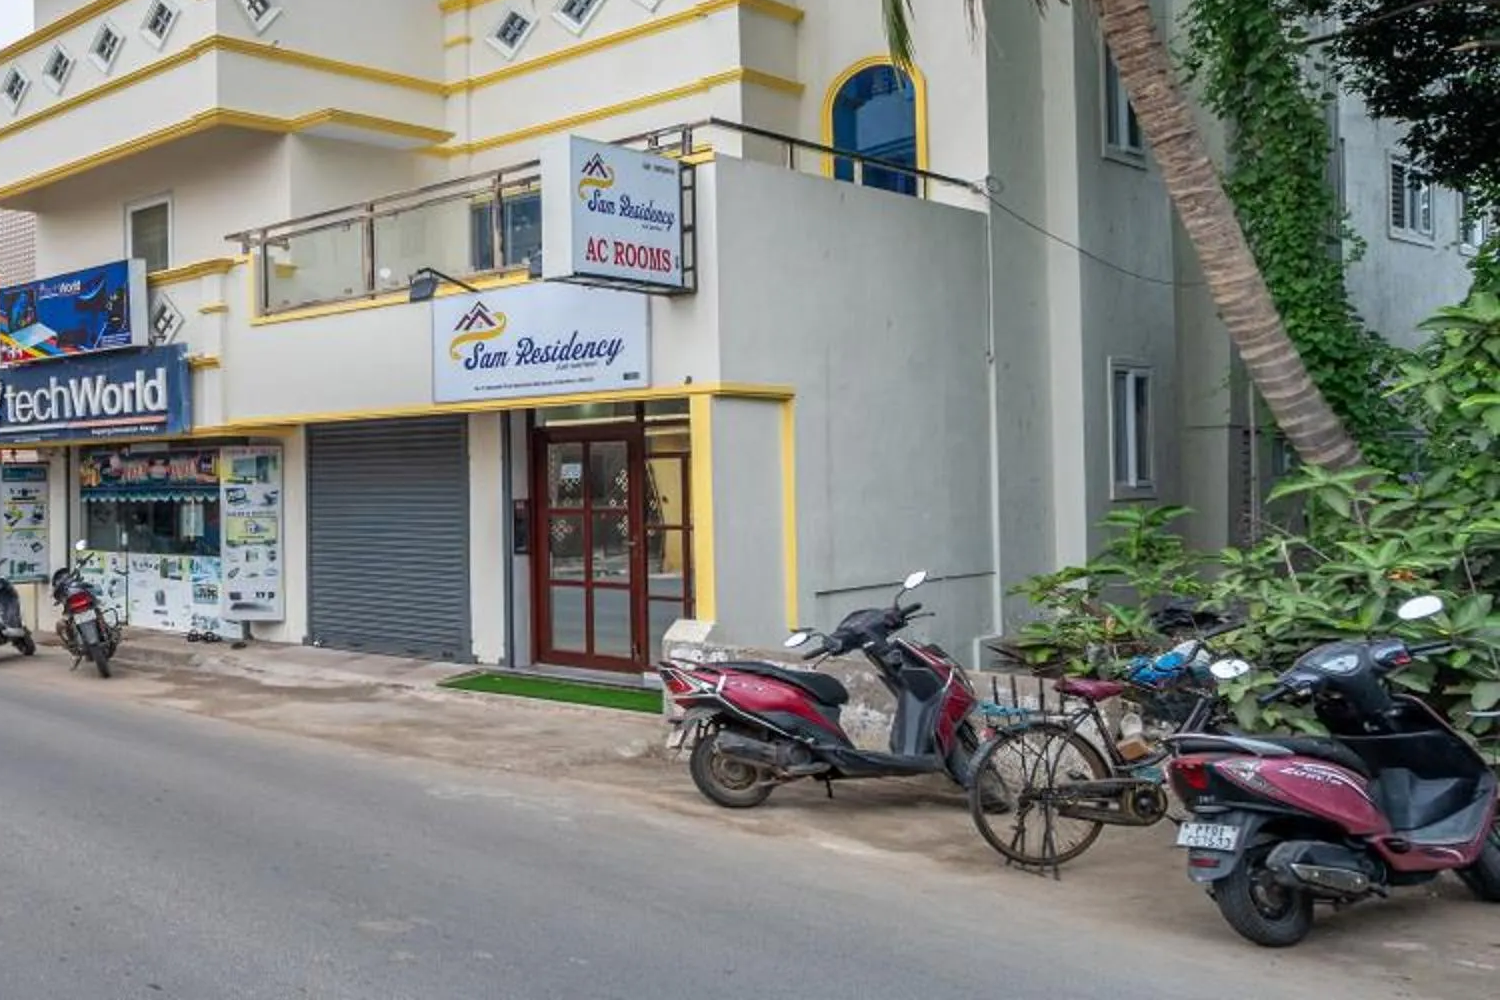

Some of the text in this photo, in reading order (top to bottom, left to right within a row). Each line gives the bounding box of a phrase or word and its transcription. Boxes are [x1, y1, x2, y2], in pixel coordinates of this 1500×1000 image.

[588, 189, 675, 231] Sam Residency
[586, 236, 609, 263] AC
[613, 240, 672, 273] ROOMS
[465, 330, 623, 370] Sam Residency
